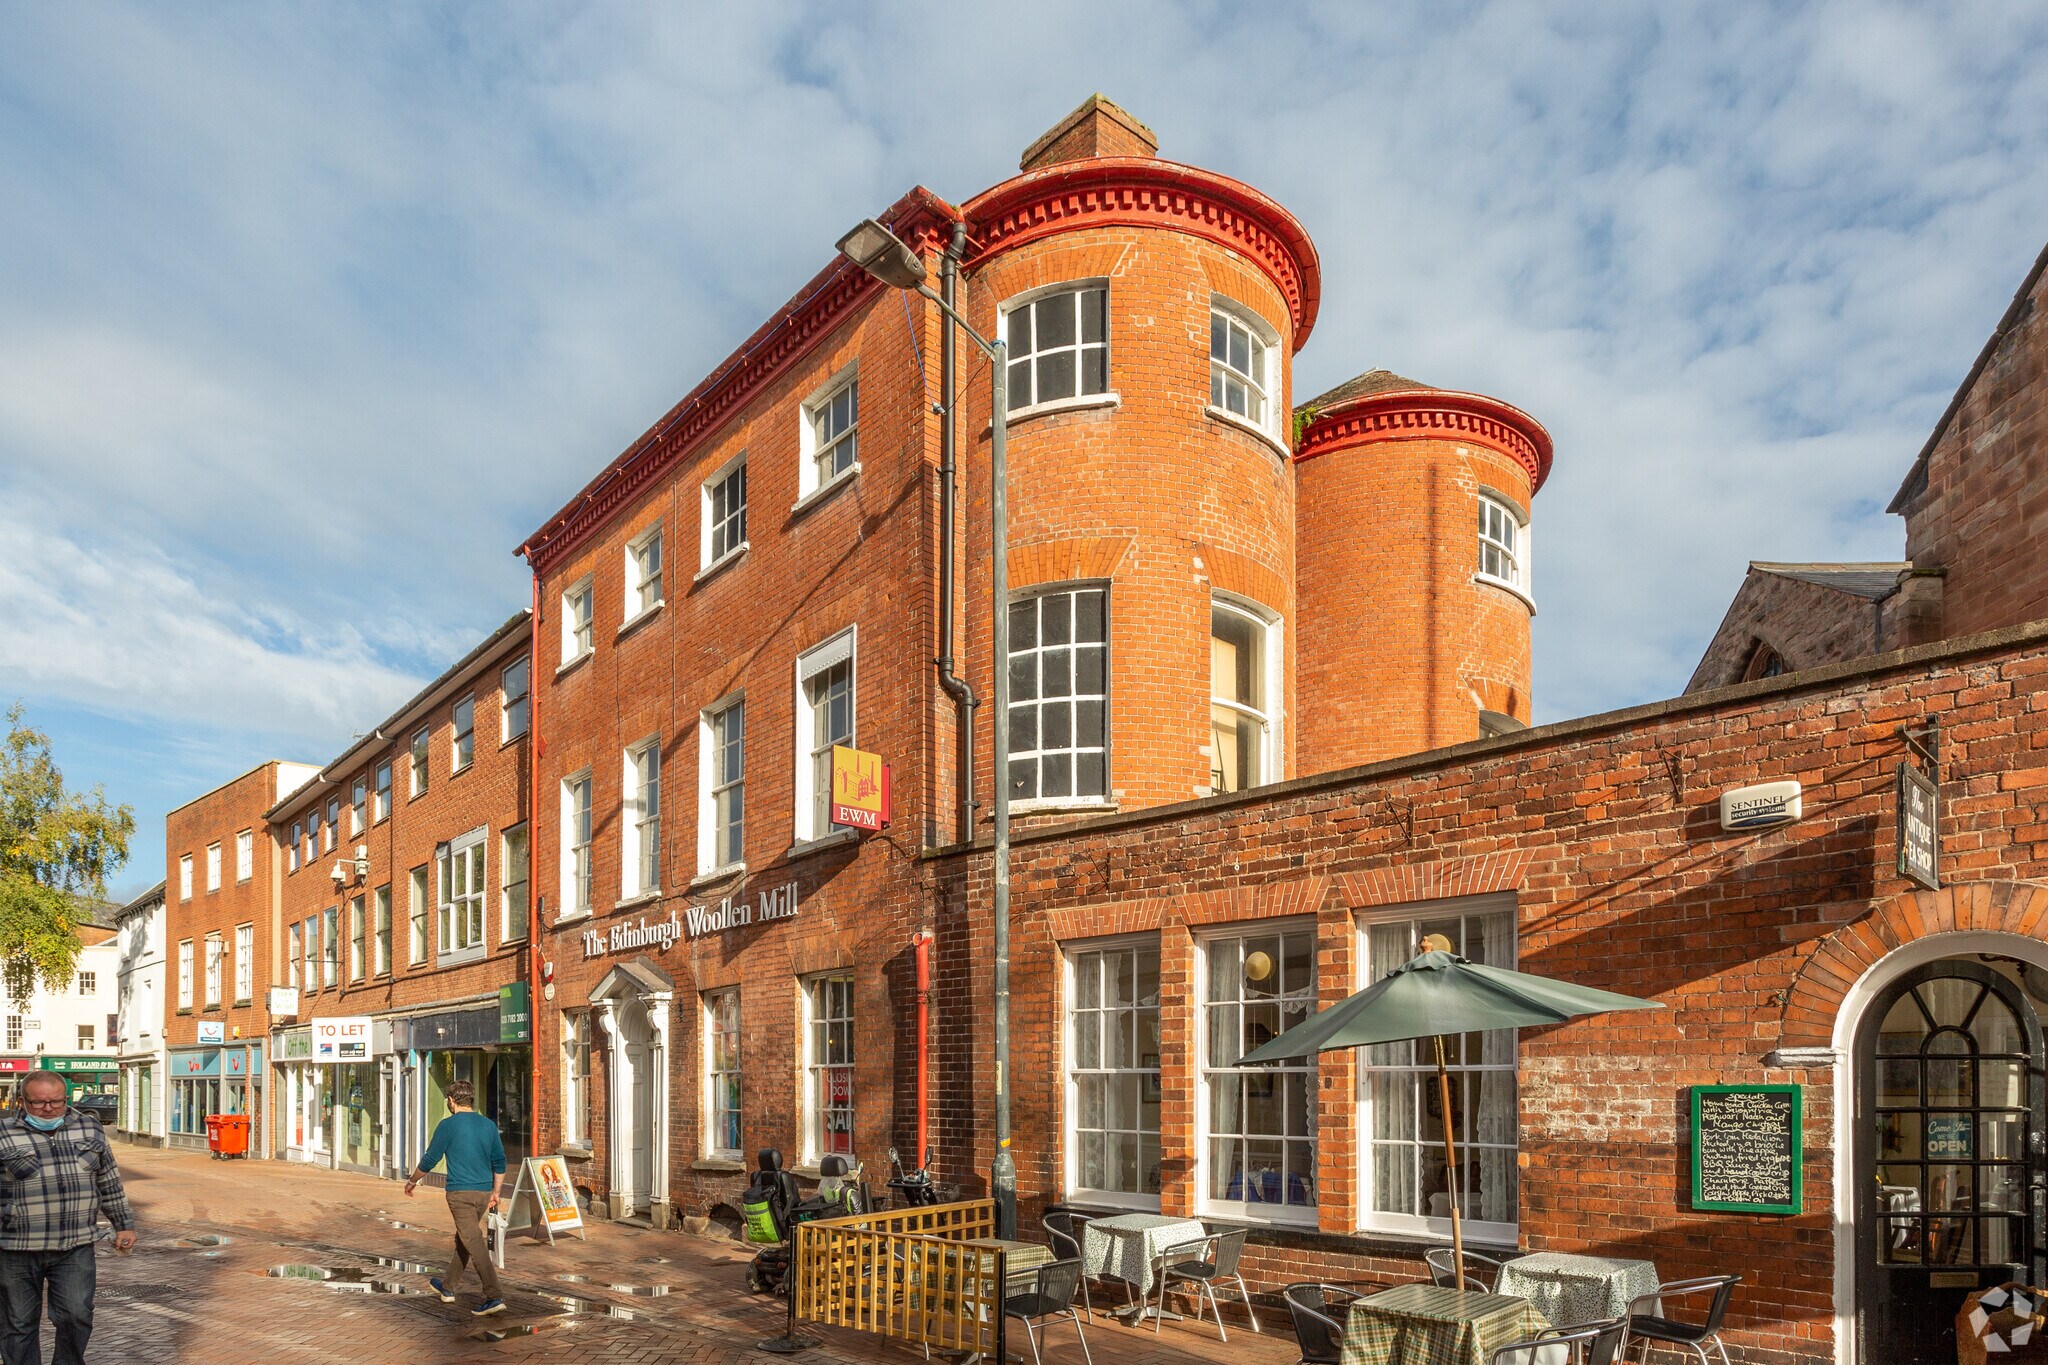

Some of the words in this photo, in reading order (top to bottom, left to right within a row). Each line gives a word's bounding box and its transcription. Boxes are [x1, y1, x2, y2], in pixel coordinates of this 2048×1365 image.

[1731, 796, 1786, 811] SENTINEL
[839, 806, 876, 827] EWM
[1731, 809, 1758, 819] security
[1758, 804, 1786, 814] systems
[1917, 847, 1932, 872] SHOP
[582, 929, 607, 957] The
[609, 910, 682, 950] Edinburgh
[685, 897, 752, 937] Woollen
[758, 881, 799, 922] Mill
[318, 1025, 336, 1036] TO
[341, 1024, 366, 1036] LET
[287, 1036, 298, 1056] Off
[299, 1036, 308, 1055] the
[70, 1061, 100, 1070] HOLLAND
[100, 1061, 107, 1070] &
[1702, 1106, 1722, 1114] with
[1742, 1111, 1764, 1120] Naan
[1765, 1113, 1786, 1122] and
[1712, 1120, 1744, 1131] Mango
[1928, 1121, 1951, 1134] Come
[1702, 1132, 1722, 1141] Pork
[1719, 1145, 1737, 1153] with
[1928, 1140, 1967, 1152] OPEN
[1702, 1159, 1724, 1168] BBQ
[1737, 1153, 1759, 1162] fried
